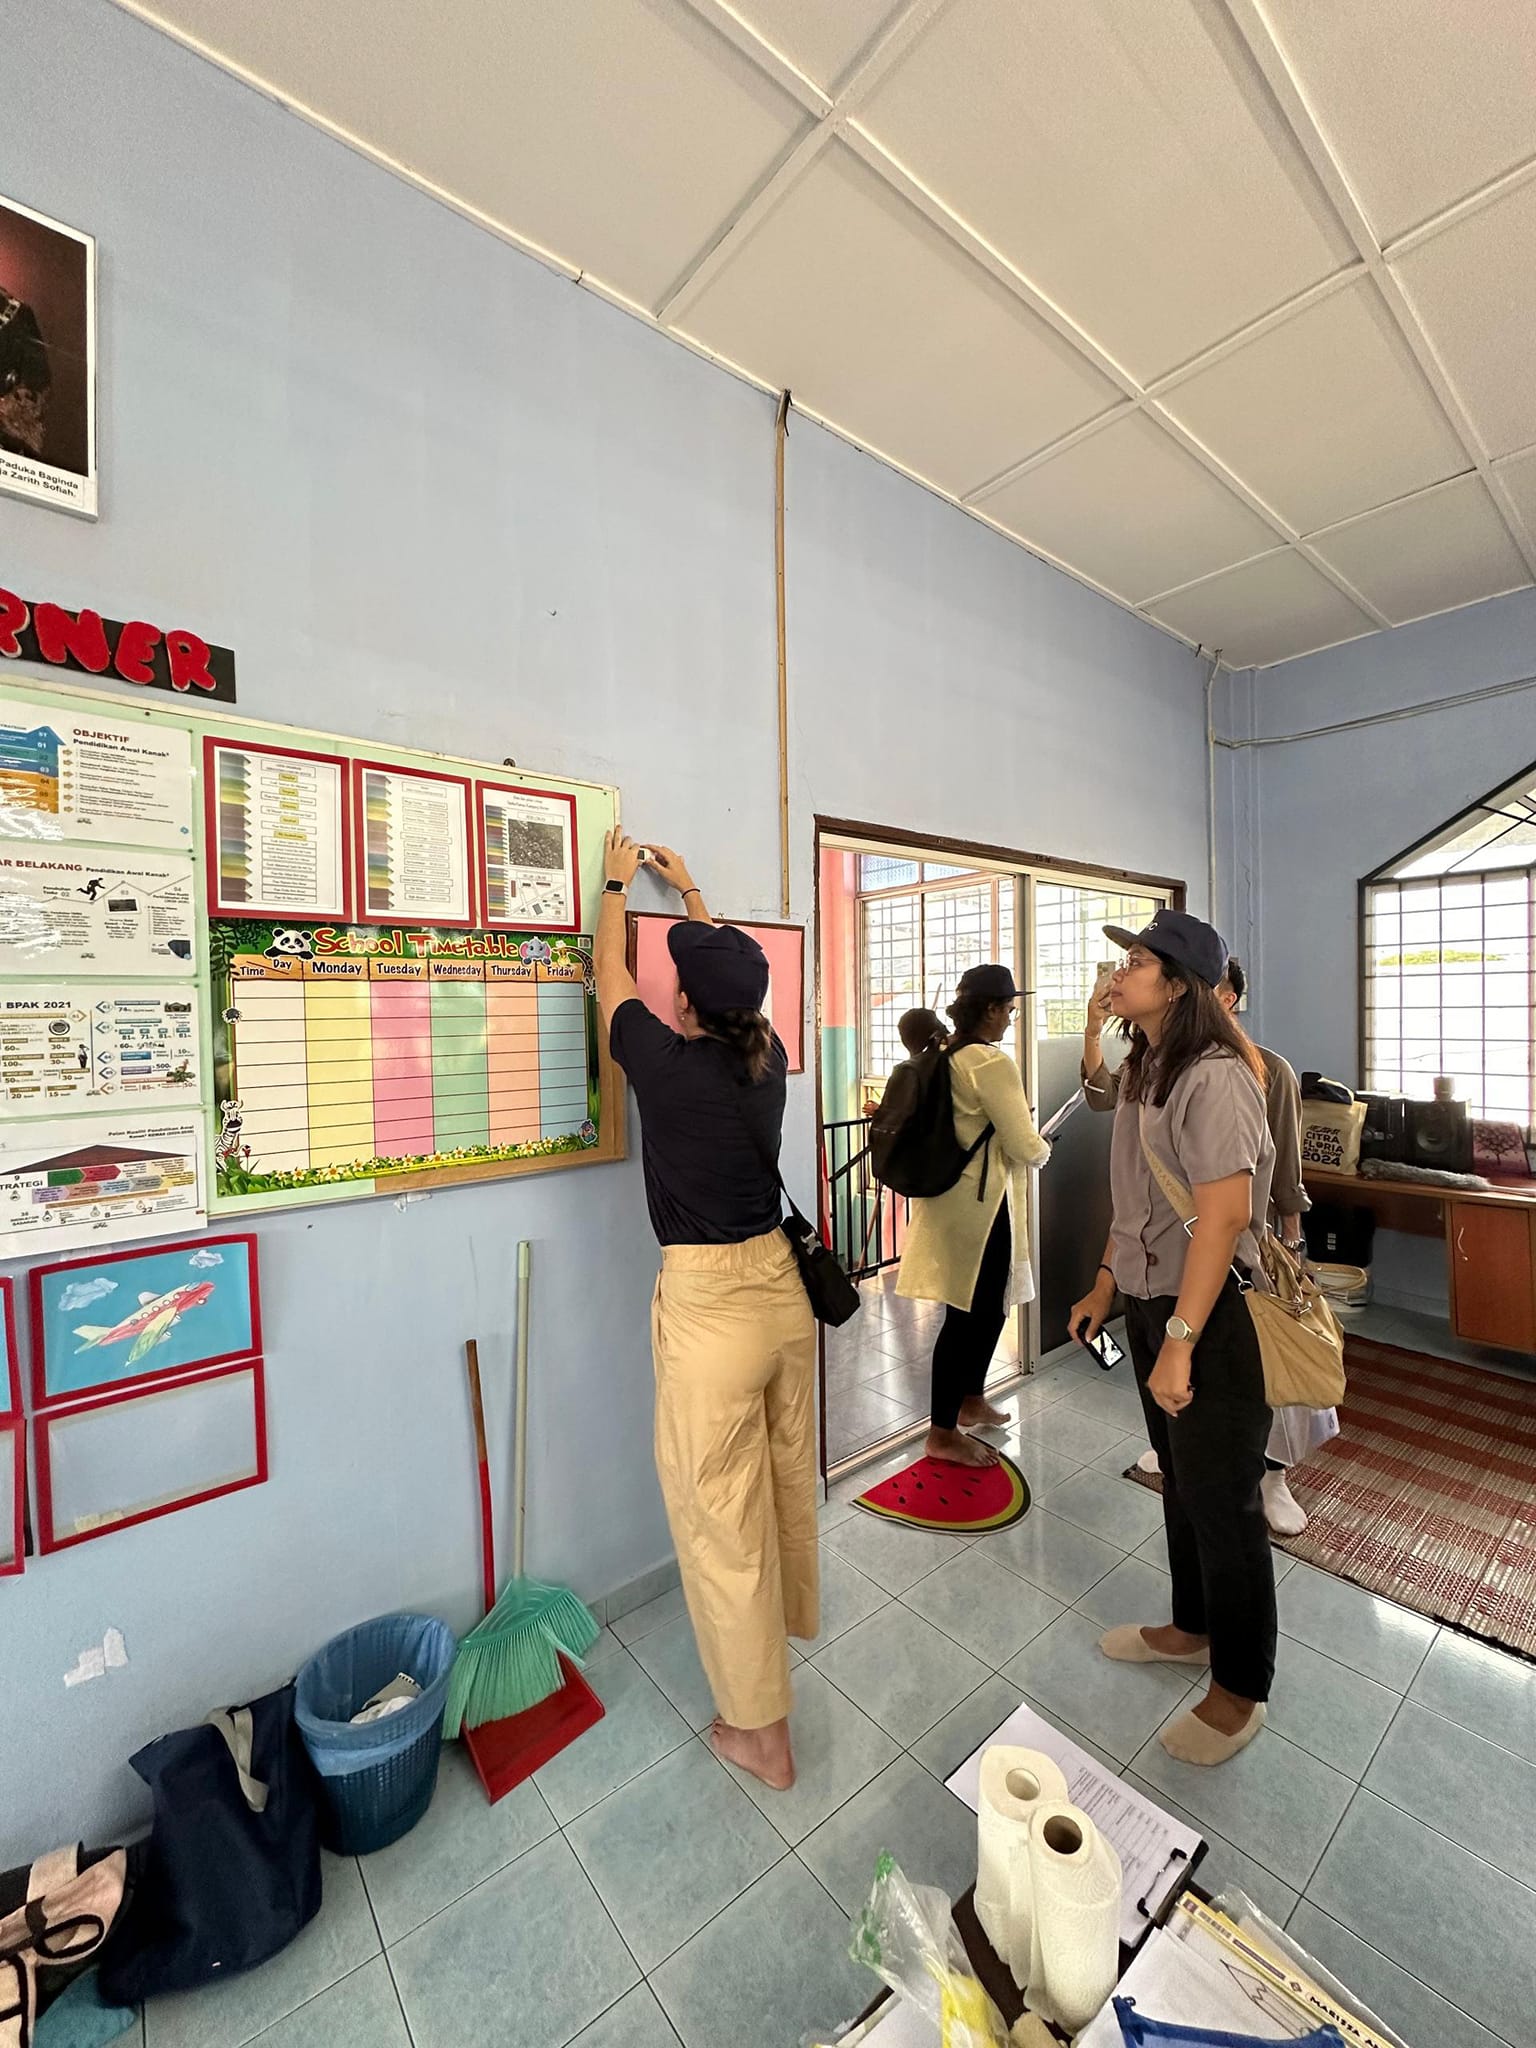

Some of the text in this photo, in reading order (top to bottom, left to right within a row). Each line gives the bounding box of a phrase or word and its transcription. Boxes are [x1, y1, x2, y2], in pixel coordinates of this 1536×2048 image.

[11, 470, 40, 486] Zarith
[38, 471, 78, 489] Baginda
[73, 728, 130, 743] OBJEKTIF
[73, 738, 118, 750] Pendidikan
[16, 860, 82, 871] BELAKANG
[86, 867, 125, 875] Pendidikan
[313, 928, 403, 955] School
[240, 966, 265, 976] Time
[273, 959, 292, 970] Day
[312, 961, 362, 975] Monday
[376, 963, 422, 977] Tuesday
[433, 964, 482, 976] Wednesday
[490, 965, 532, 977] Thursday
[547, 966, 575, 978] Friday
[6, 1001, 71, 1009] BPAK 2021
[1306, 1131, 1340, 1144] CITRA
[1303, 1138, 1344, 1154] FLORIA
[1301, 1151, 1341, 1167] 2024
[0, 1180, 43, 1190] TRATEGI
